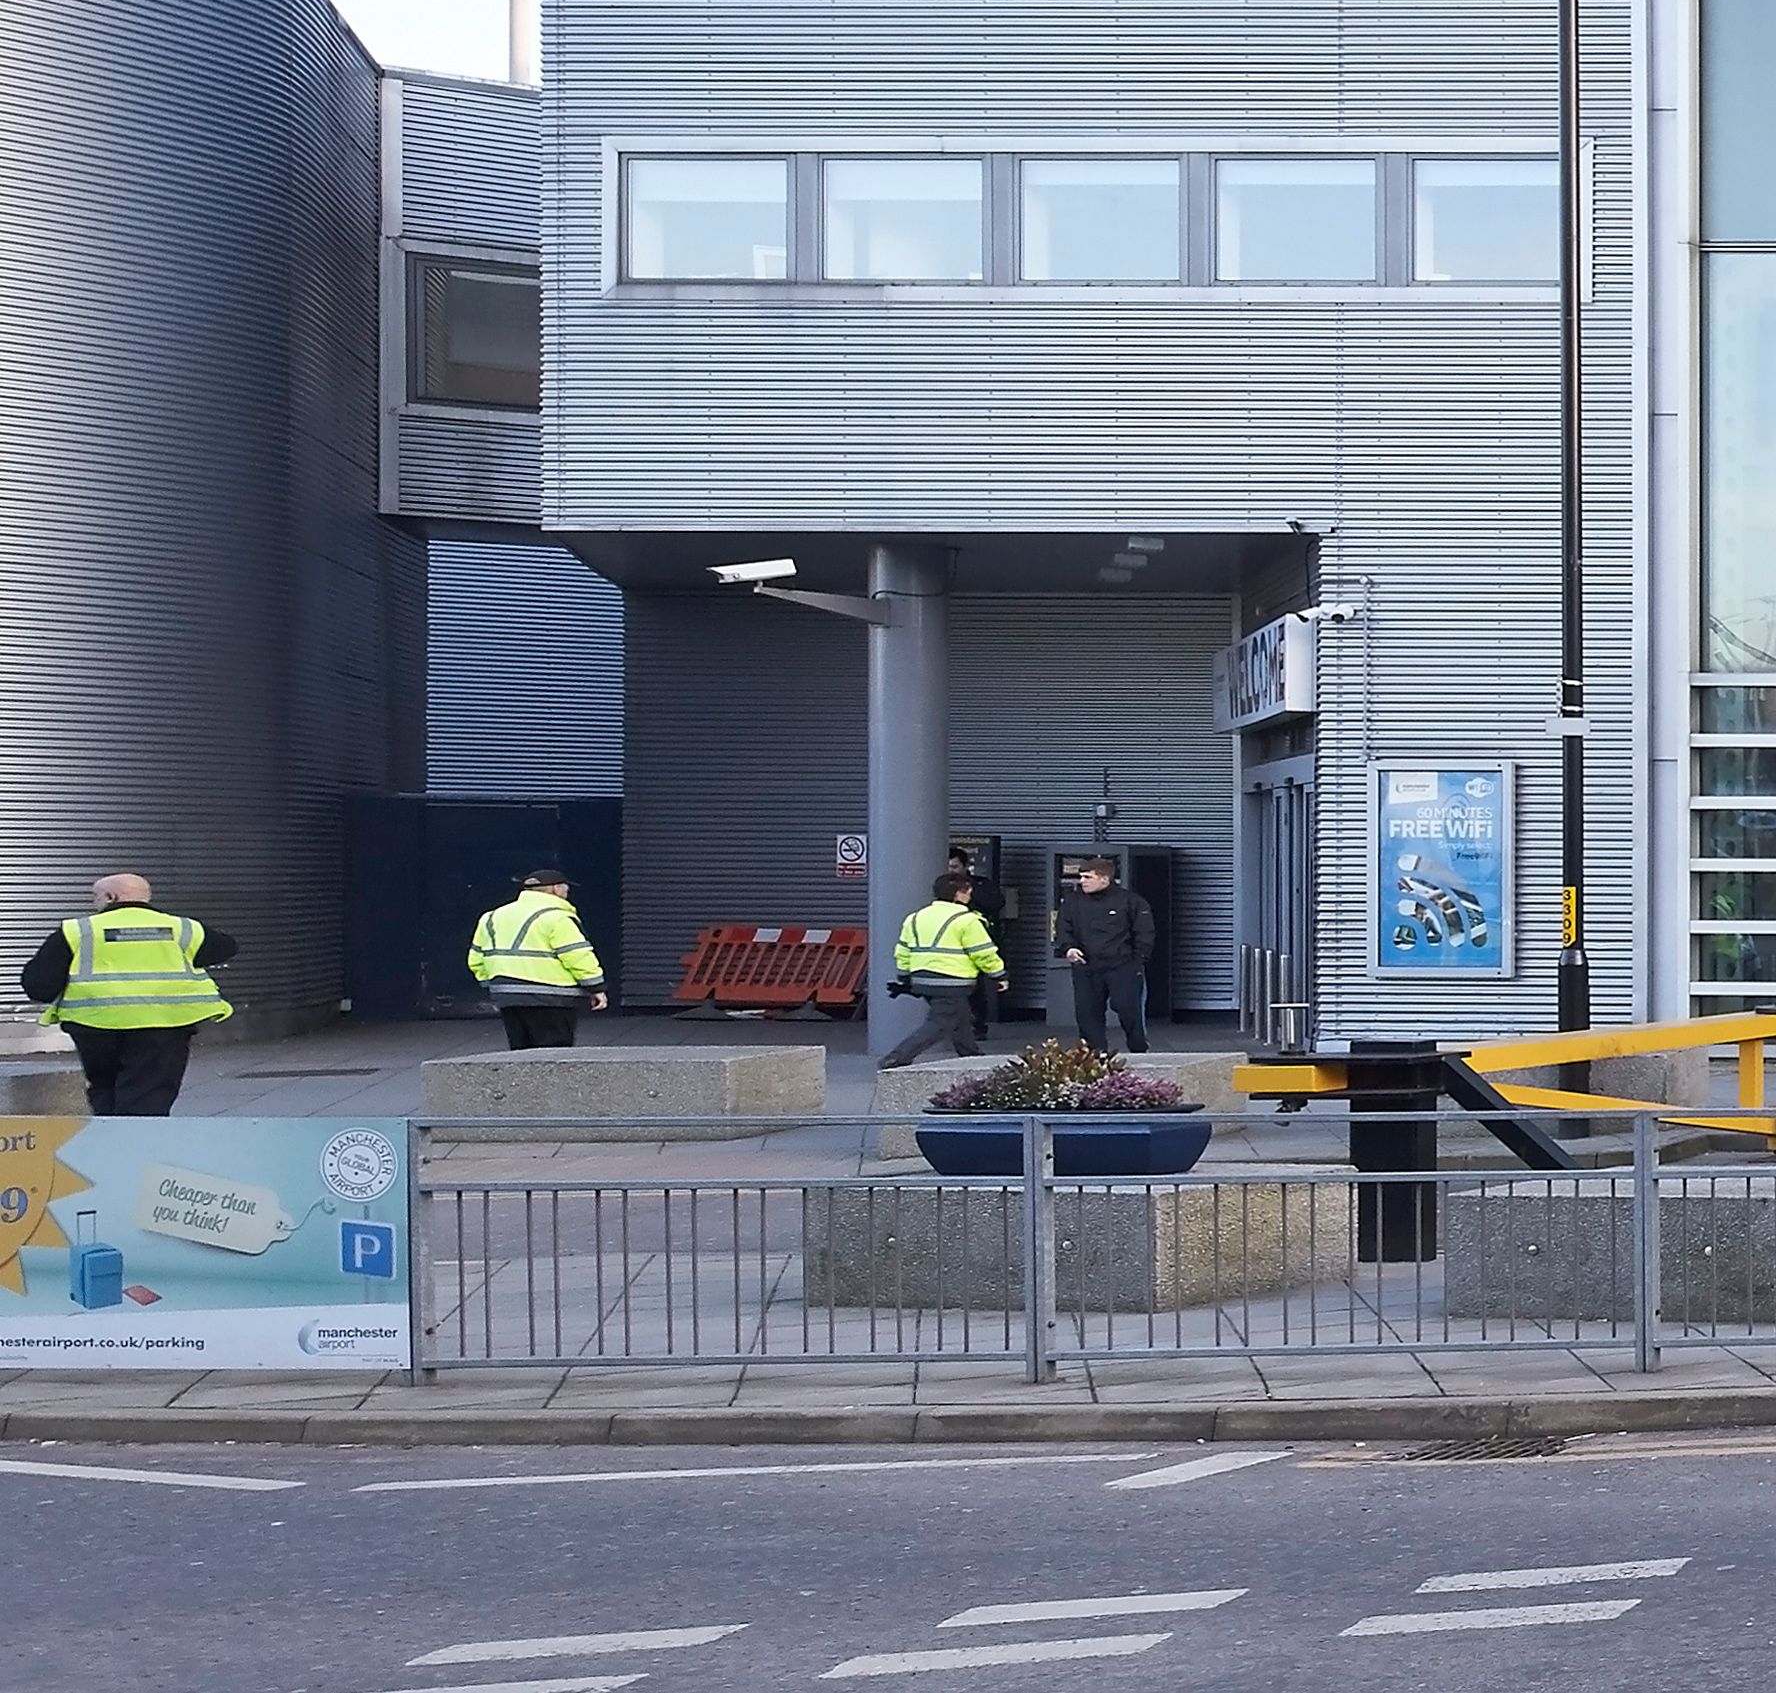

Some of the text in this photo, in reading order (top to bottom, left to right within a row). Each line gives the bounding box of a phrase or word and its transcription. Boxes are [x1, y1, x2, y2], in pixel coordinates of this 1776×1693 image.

[1227, 623, 1285, 720] WELCOME
[1389, 819, 1493, 838] FREE WiFi
[1563, 889, 1572, 944] 3309
[328, 1133, 393, 1176] MANCHESTER
[158, 1178, 256, 1216] Cheaper than
[328, 1174, 375, 1196] AIRPORT
[152, 1204, 230, 1235] you think!
[354, 1233, 381, 1268] P
[317, 1327, 398, 1338] manchester
[318, 1339, 356, 1350] airport
